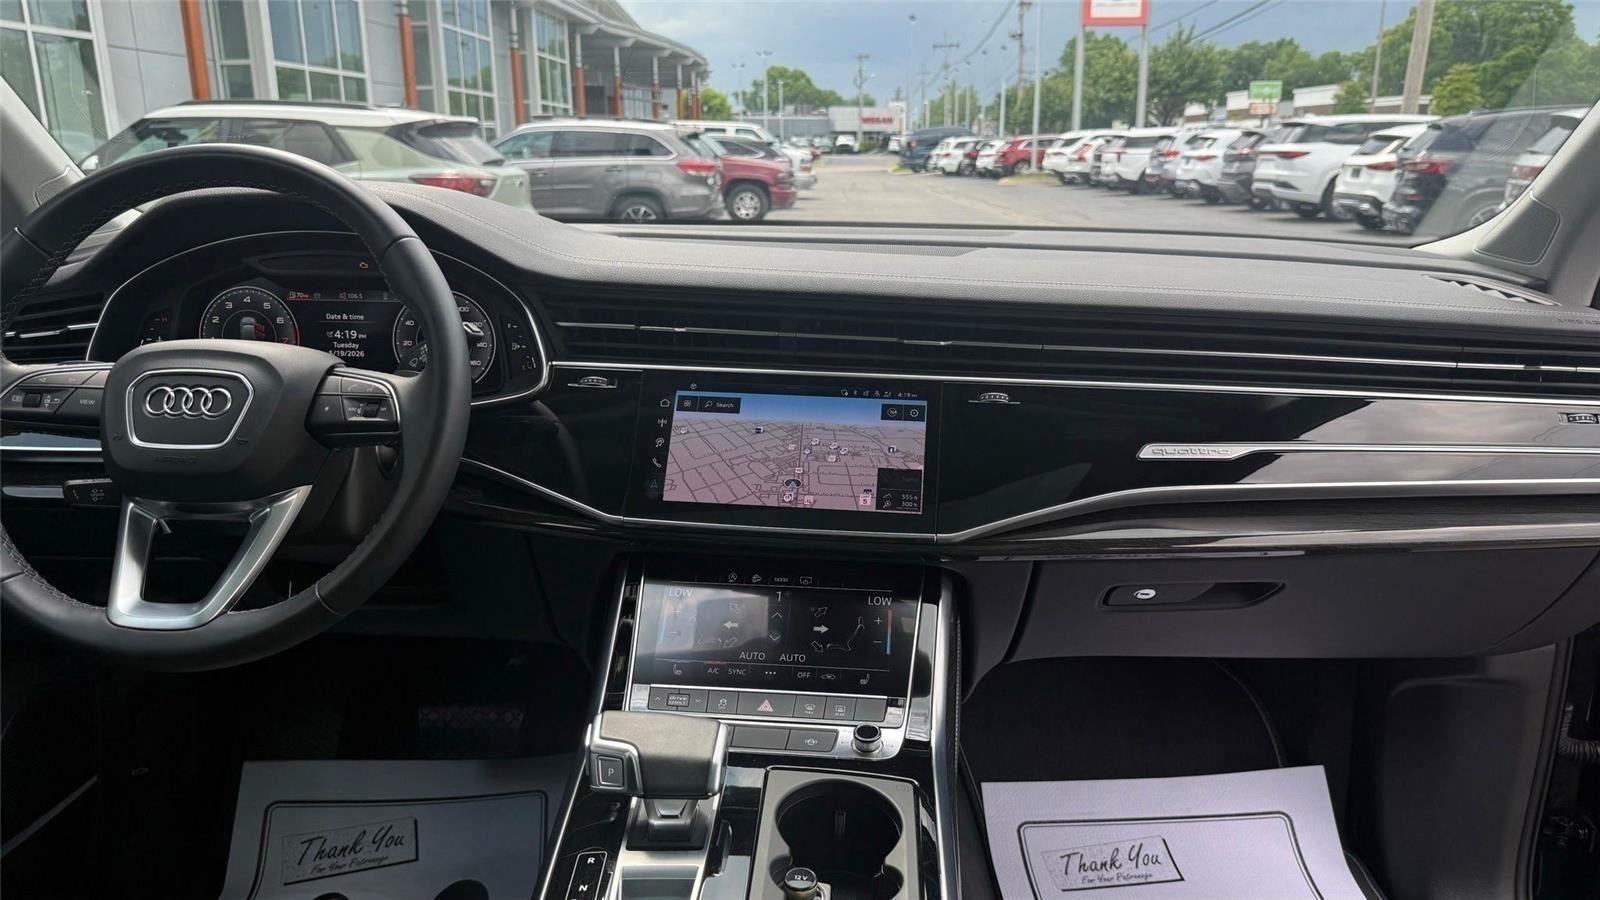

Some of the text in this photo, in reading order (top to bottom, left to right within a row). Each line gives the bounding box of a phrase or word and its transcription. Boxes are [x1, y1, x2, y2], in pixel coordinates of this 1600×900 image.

[334, 330, 357, 339] 4:19
[333, 341, 360, 350] Tuesday
[1152, 447, 1231, 457] quattro
[669, 587, 693, 598] LOW
[868, 596, 893, 606] LOW
[739, 651, 766, 661] AUTO
[779, 653, 806, 663] AUTO
[608, 768, 615, 776] P
[297, 824, 405, 866] Thank You
[1059, 843, 1162, 876] Thank You
[310, 865, 325, 875] For
[328, 861, 348, 873] Your
[1081, 875, 1096, 884] For
[1098, 874, 1114, 884] Your
[578, 884, 589, 892] N
